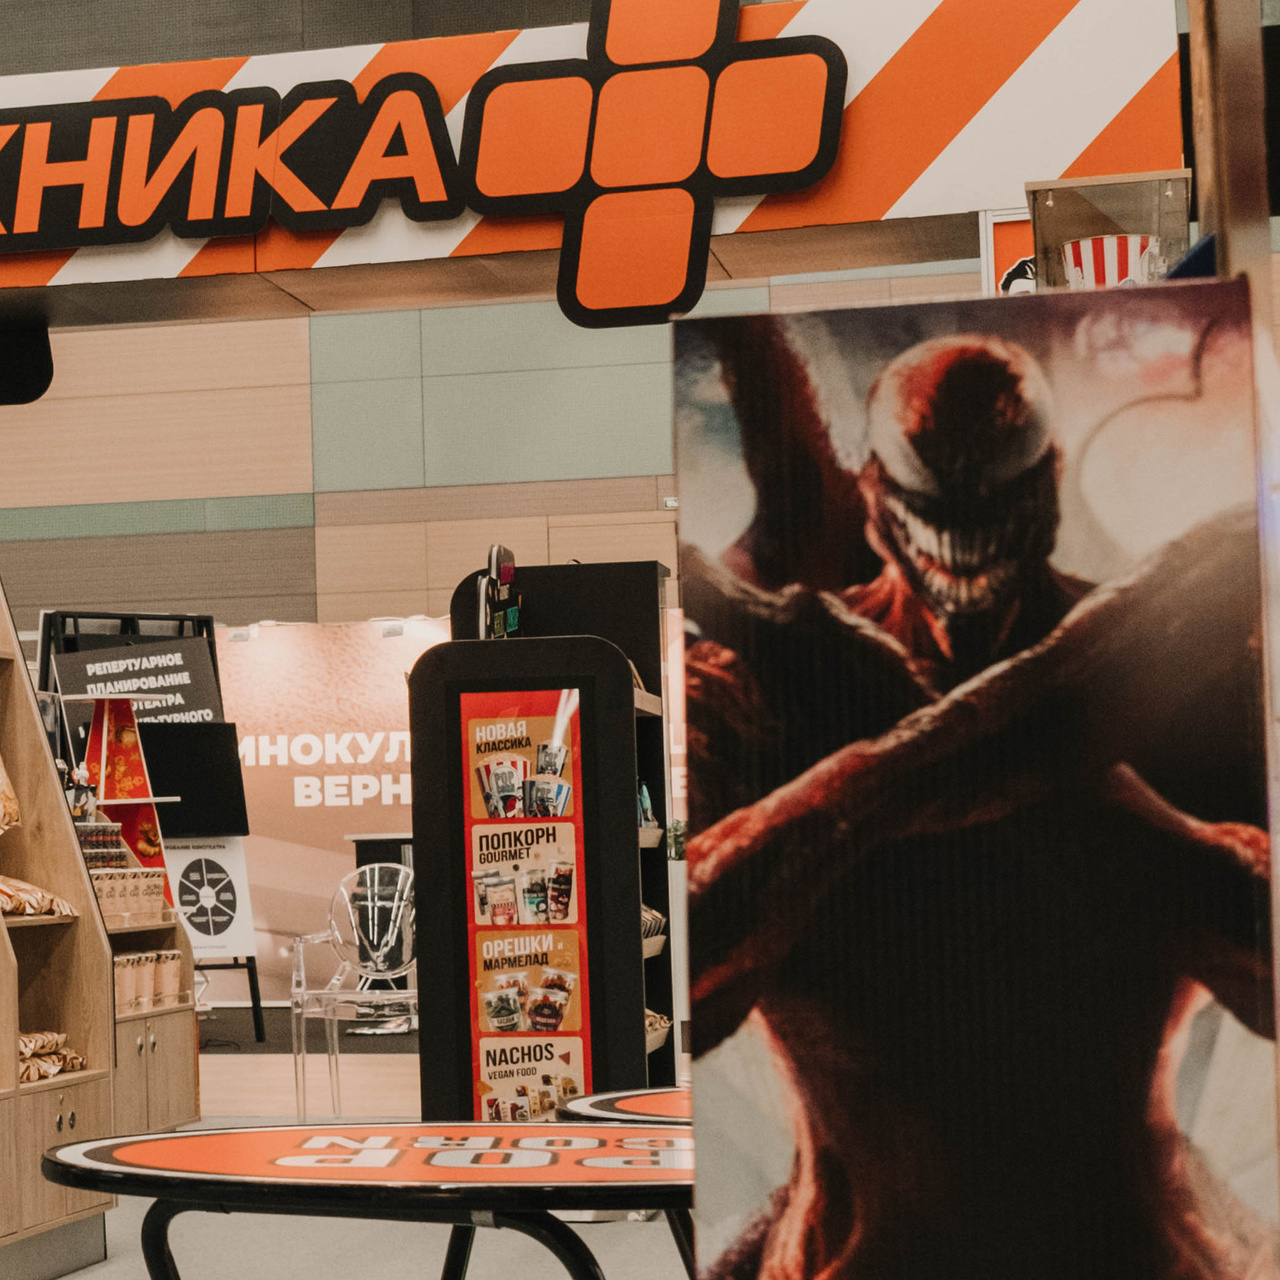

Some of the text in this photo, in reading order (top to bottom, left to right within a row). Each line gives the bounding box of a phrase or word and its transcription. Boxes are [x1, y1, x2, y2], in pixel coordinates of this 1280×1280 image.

[86, 652, 184, 677] РЕПЕРТУАРНОЕ
[86, 672, 191, 695] ПЛАНИРОВАНИЕ
[475, 721, 527, 742] НОВАЯ
[476, 737, 532, 754] КЛАССИКА
[479, 826, 557, 852] ПОПКОРН
[479, 847, 531, 864] GOURMET
[482, 934, 554, 958] ОРЕШКИ
[483, 953, 549, 971] МАРМЕЛАД
[486, 1043, 554, 1067] NACHOS
[488, 1067, 537, 1080] VEGAN FOOD
